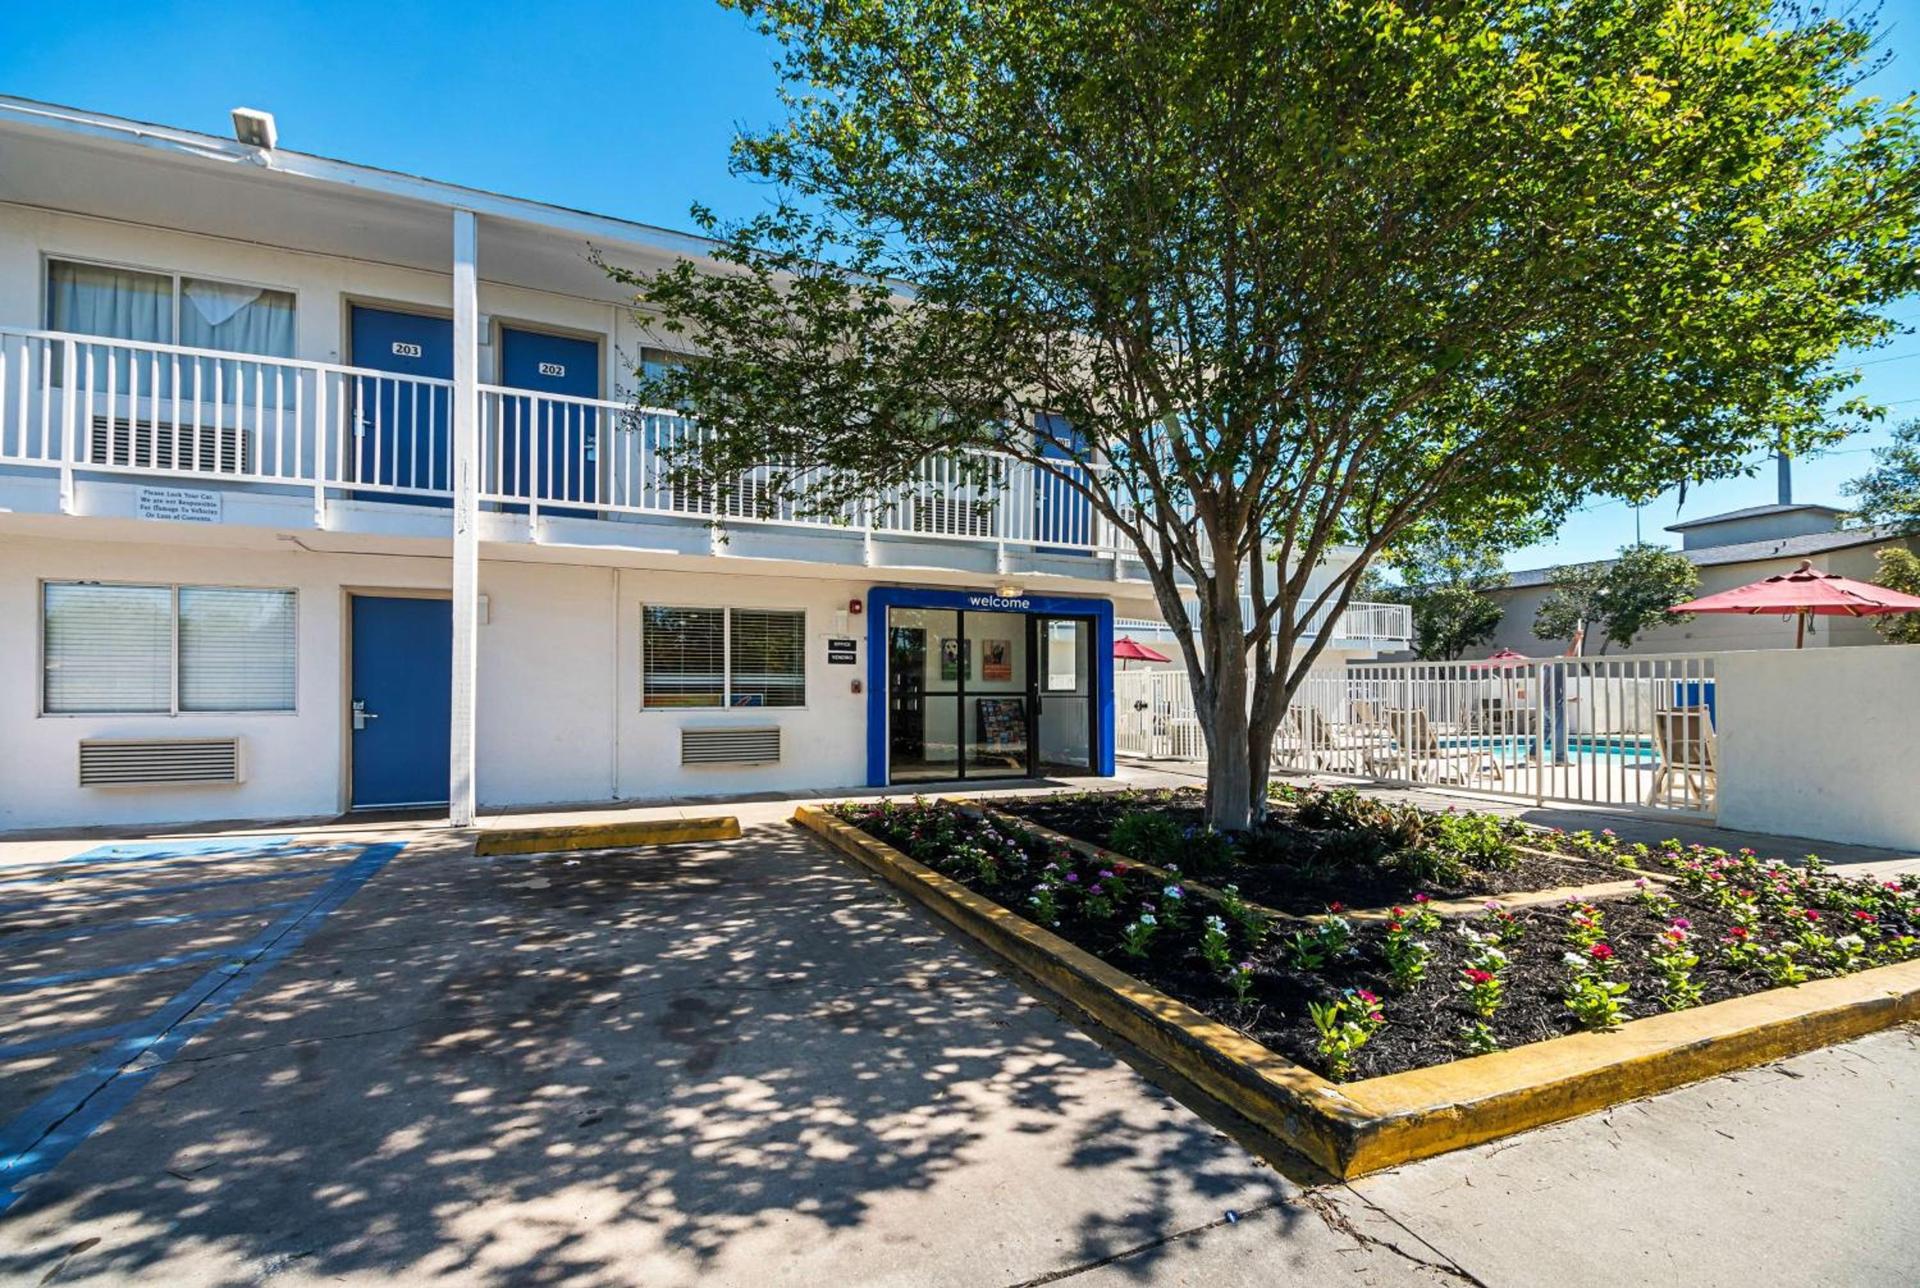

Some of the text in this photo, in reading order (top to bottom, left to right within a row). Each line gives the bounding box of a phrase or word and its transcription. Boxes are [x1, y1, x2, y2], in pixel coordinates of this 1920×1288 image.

[396, 344, 418, 355] 203
[542, 364, 562, 375] 202
[153, 504, 178, 512] Damage
[969, 595, 1030, 609] welcome
